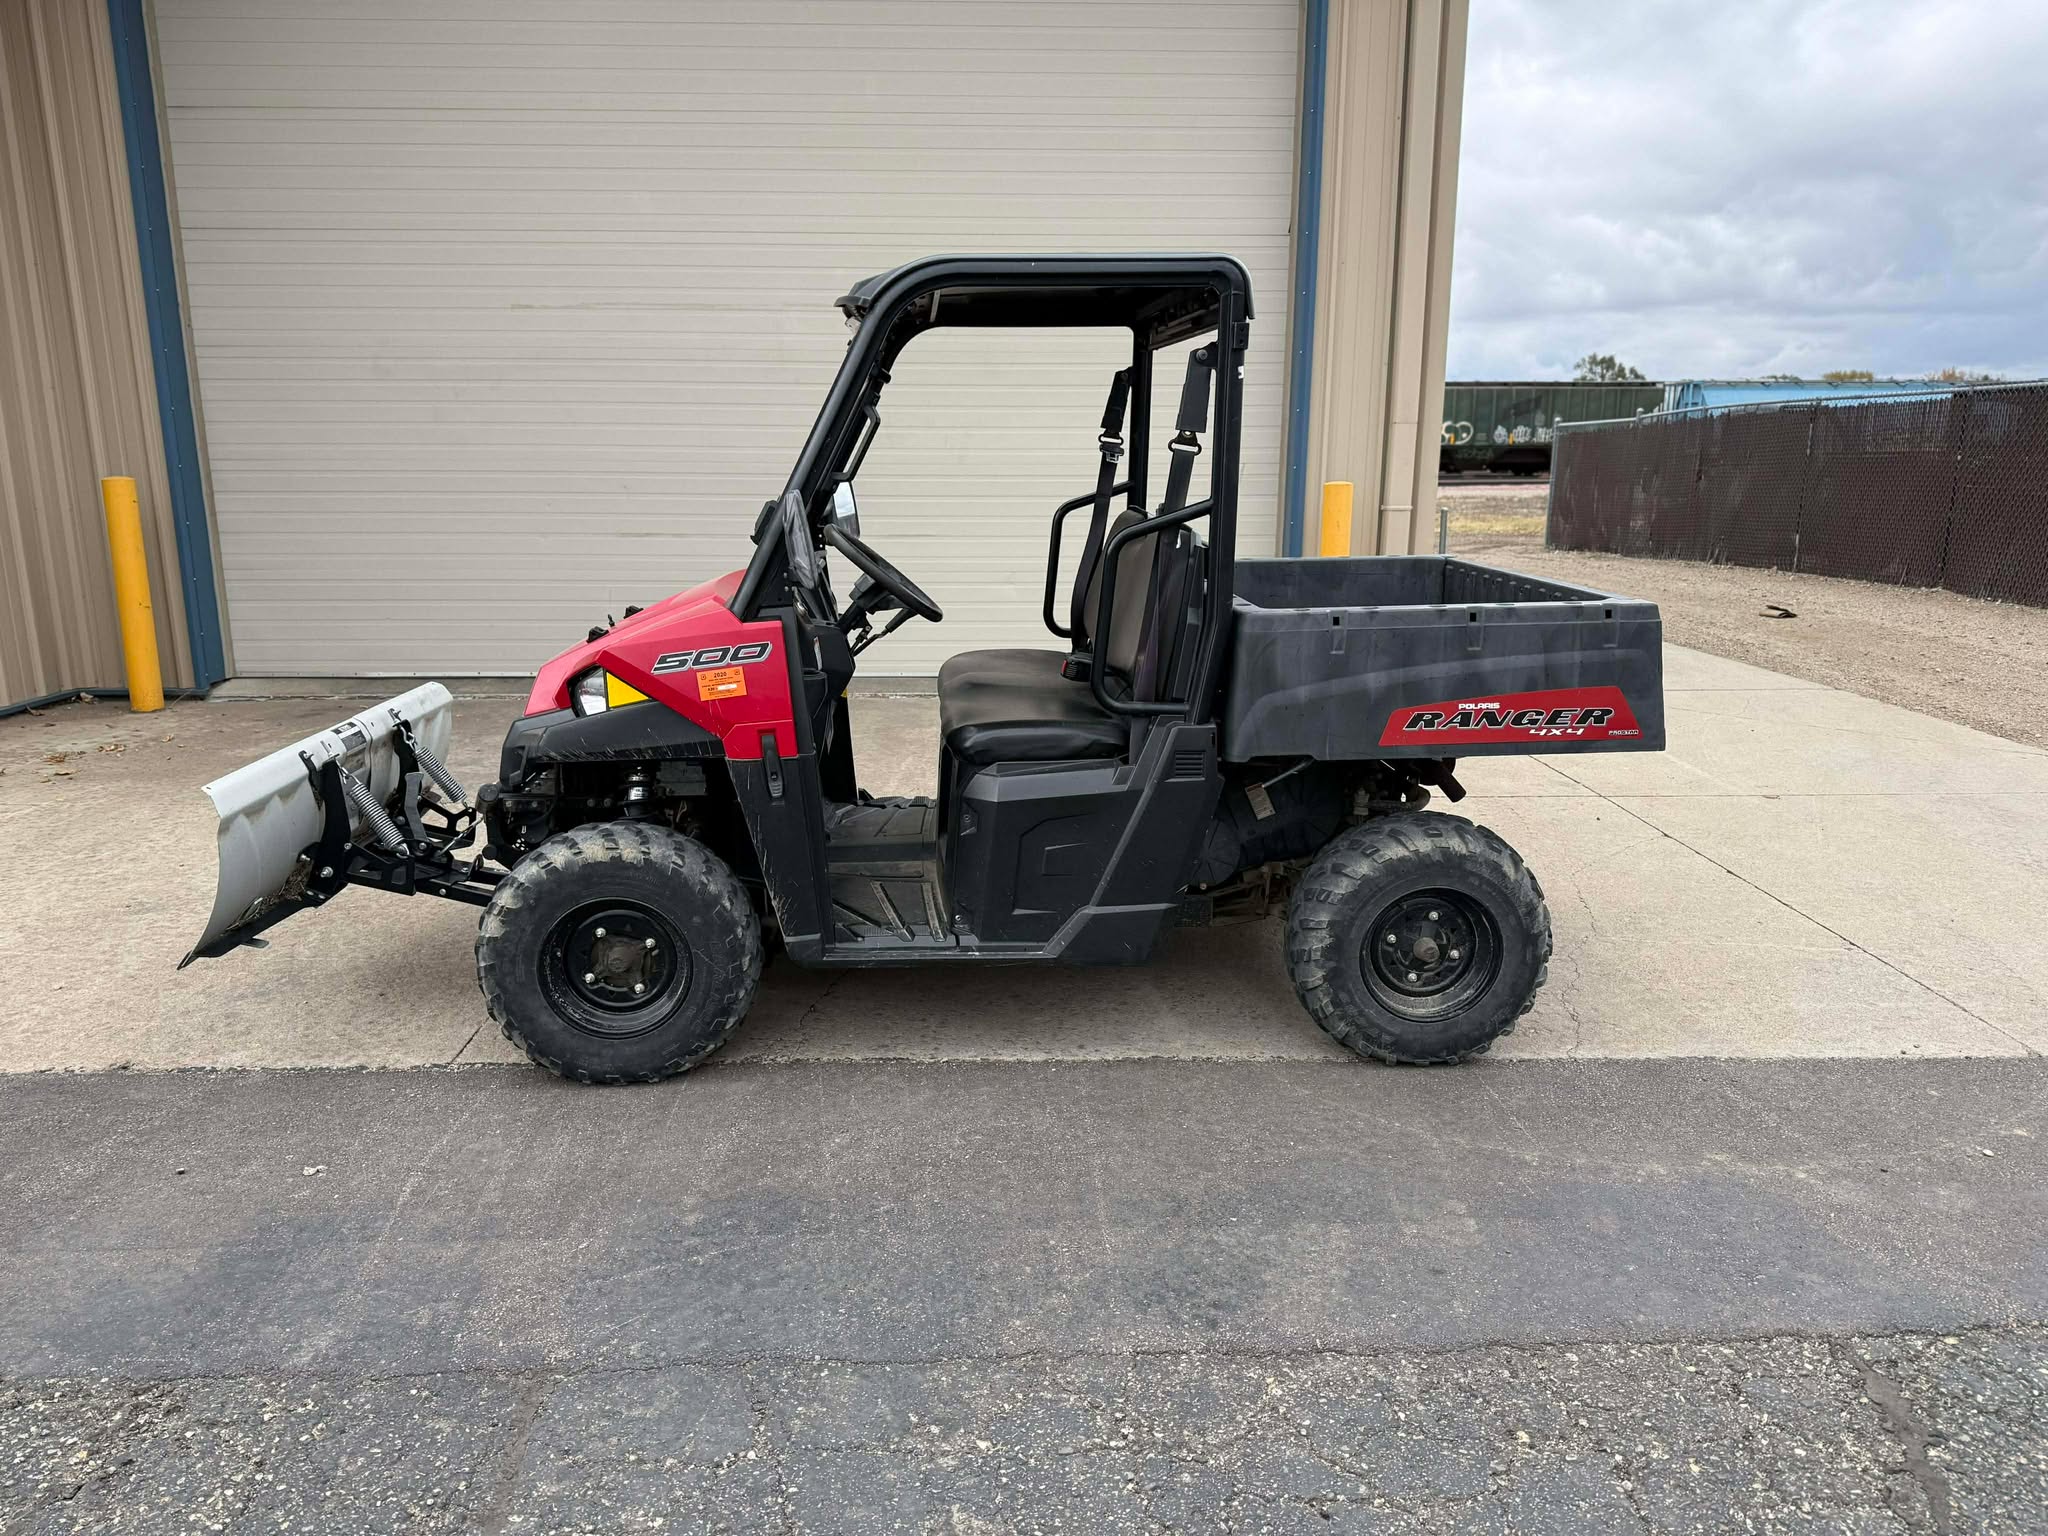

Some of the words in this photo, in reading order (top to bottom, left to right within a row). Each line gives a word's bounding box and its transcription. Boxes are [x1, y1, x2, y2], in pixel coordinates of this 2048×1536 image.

[651, 641, 773, 675] 500
[1458, 702, 1501, 711] POLARIS
[1402, 707, 1615, 731] RANGER
